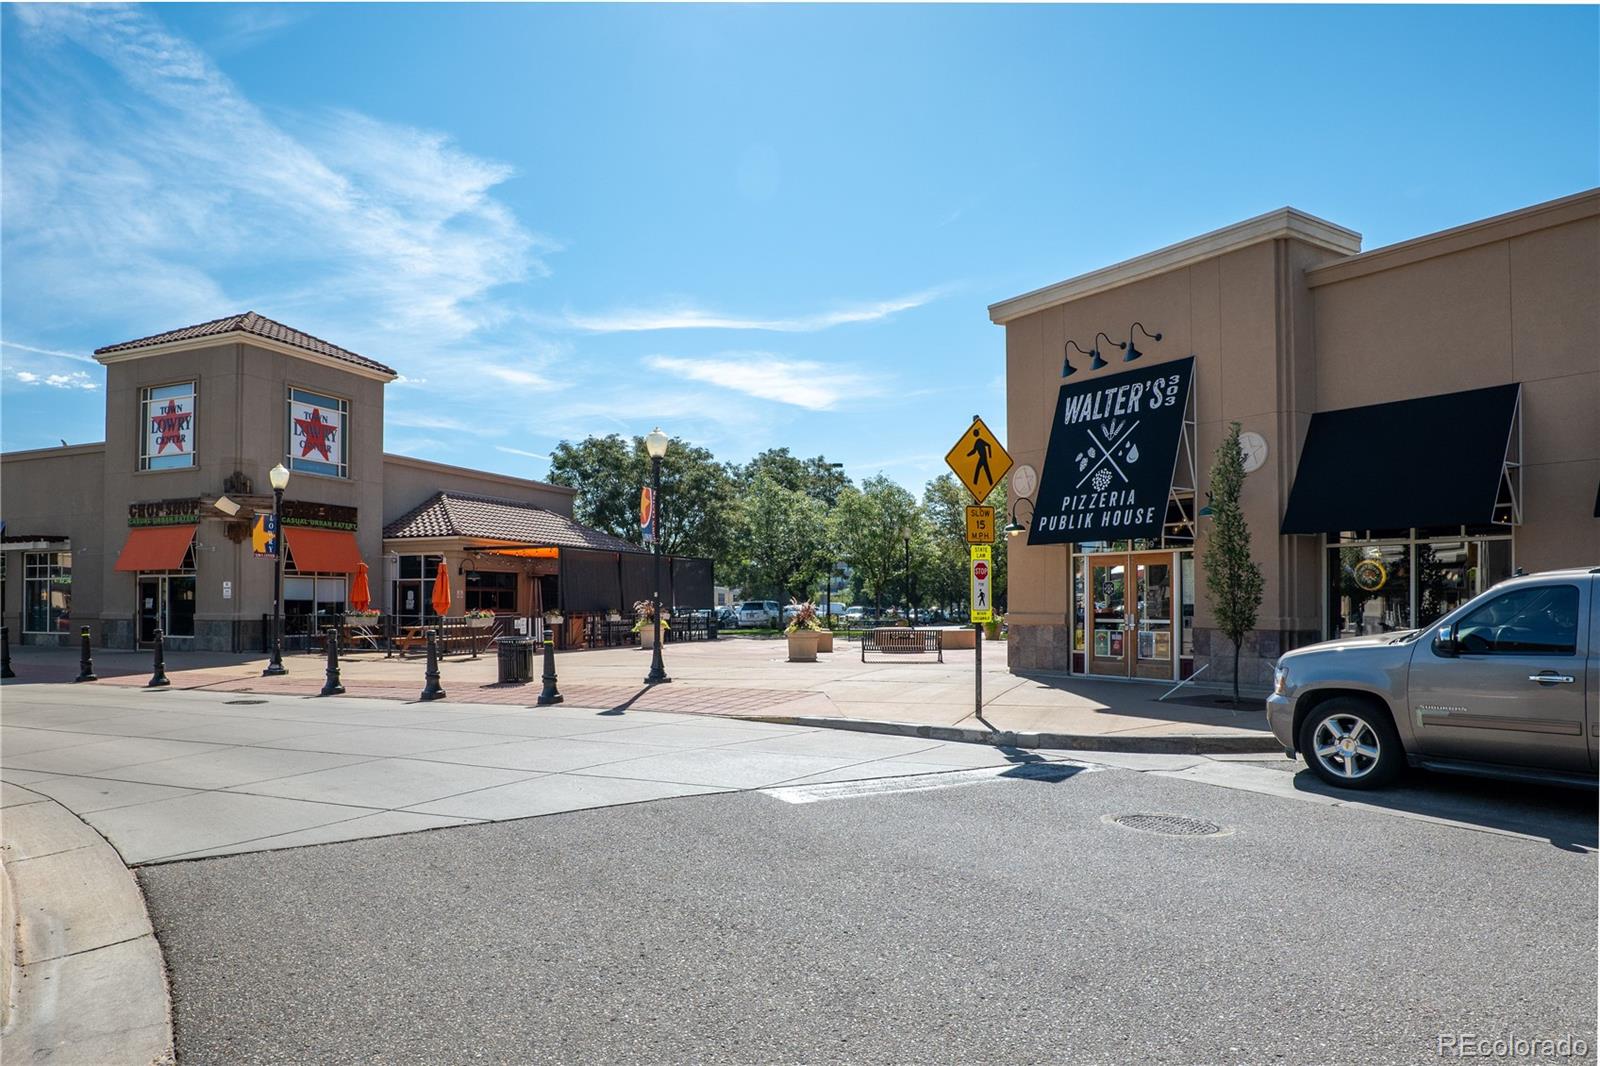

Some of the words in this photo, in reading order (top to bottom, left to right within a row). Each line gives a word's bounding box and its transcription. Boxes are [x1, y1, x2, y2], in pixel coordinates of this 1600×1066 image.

[1165, 375, 1180, 406] 303
[160, 403, 183, 415] TOWN
[1064, 377, 1165, 424] WALTER'S
[151, 415, 192, 434] LOWRY
[155, 434, 186, 446] CENTER
[1062, 490, 1135, 511] PIZZERIA
[128, 503, 163, 518] CHOP
[970, 509, 990, 517] SLOW
[1039, 512, 1093, 531] PUBLIK
[1101, 506, 1156, 528] HOUSE
[976, 519, 986, 530] 15
